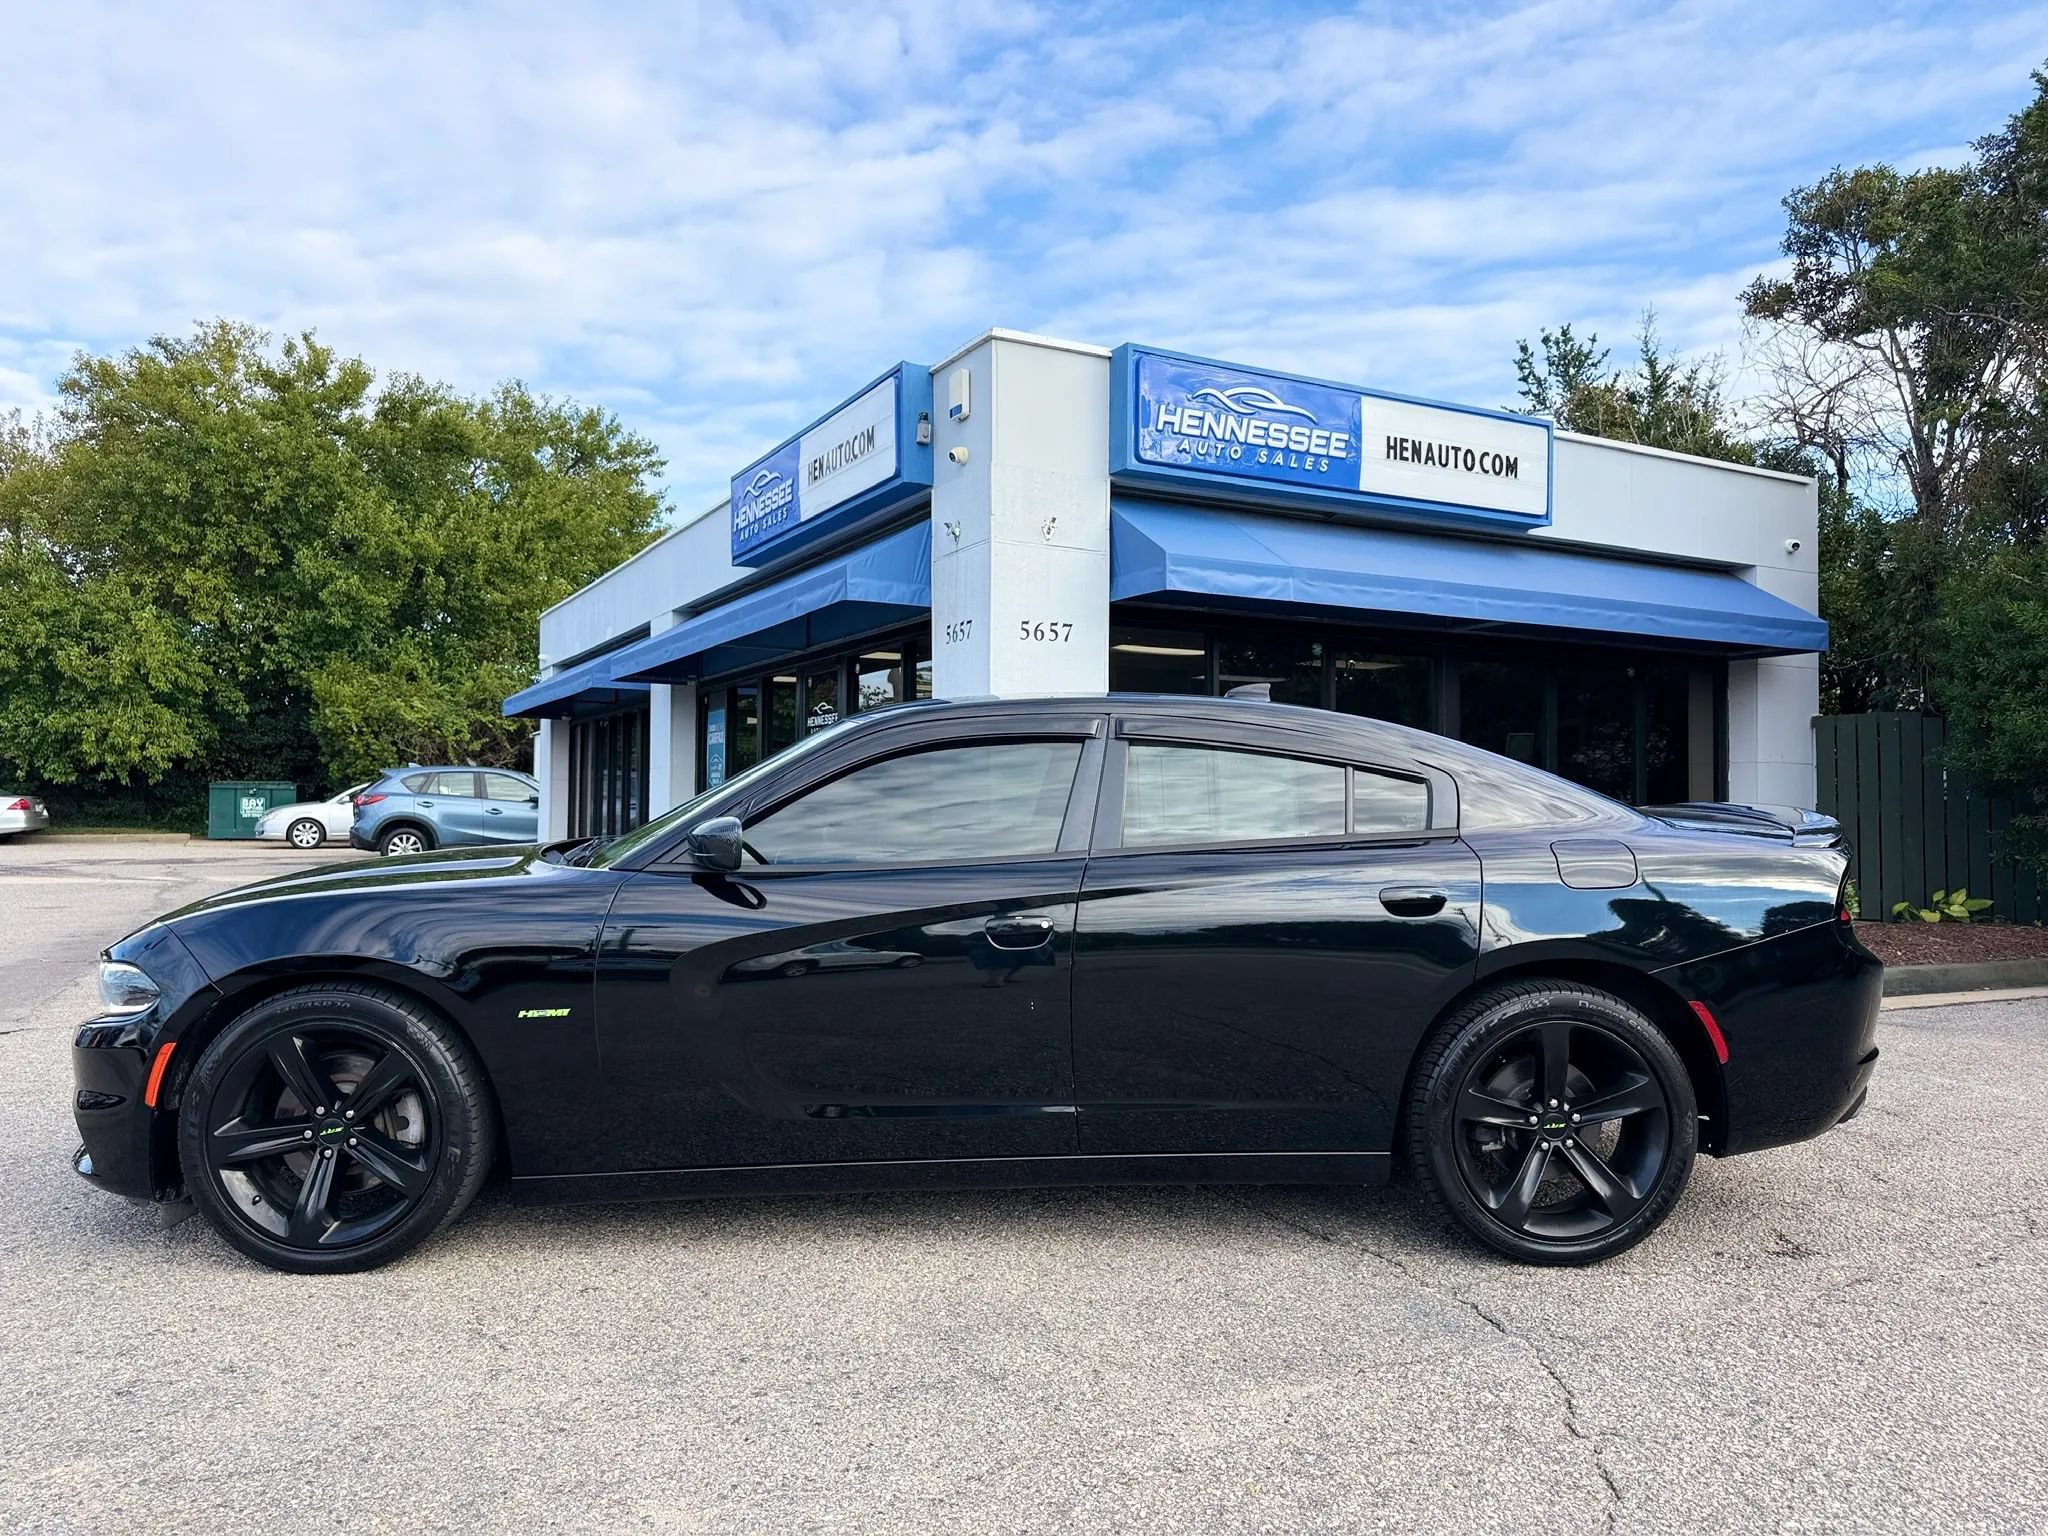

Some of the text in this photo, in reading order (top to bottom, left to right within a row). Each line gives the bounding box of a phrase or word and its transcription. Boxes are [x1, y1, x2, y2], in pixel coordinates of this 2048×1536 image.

[1156, 404, 1350, 459] HENNESSEE
[807, 426, 875, 486] HENAUTO.COM
[1178, 438, 1330, 473] AUTO SALES
[733, 477, 794, 532] HENNESSEE
[740, 506, 787, 542] AUTO SALES
[945, 619, 973, 645] 5657
[1019, 620, 1073, 642] 5657
